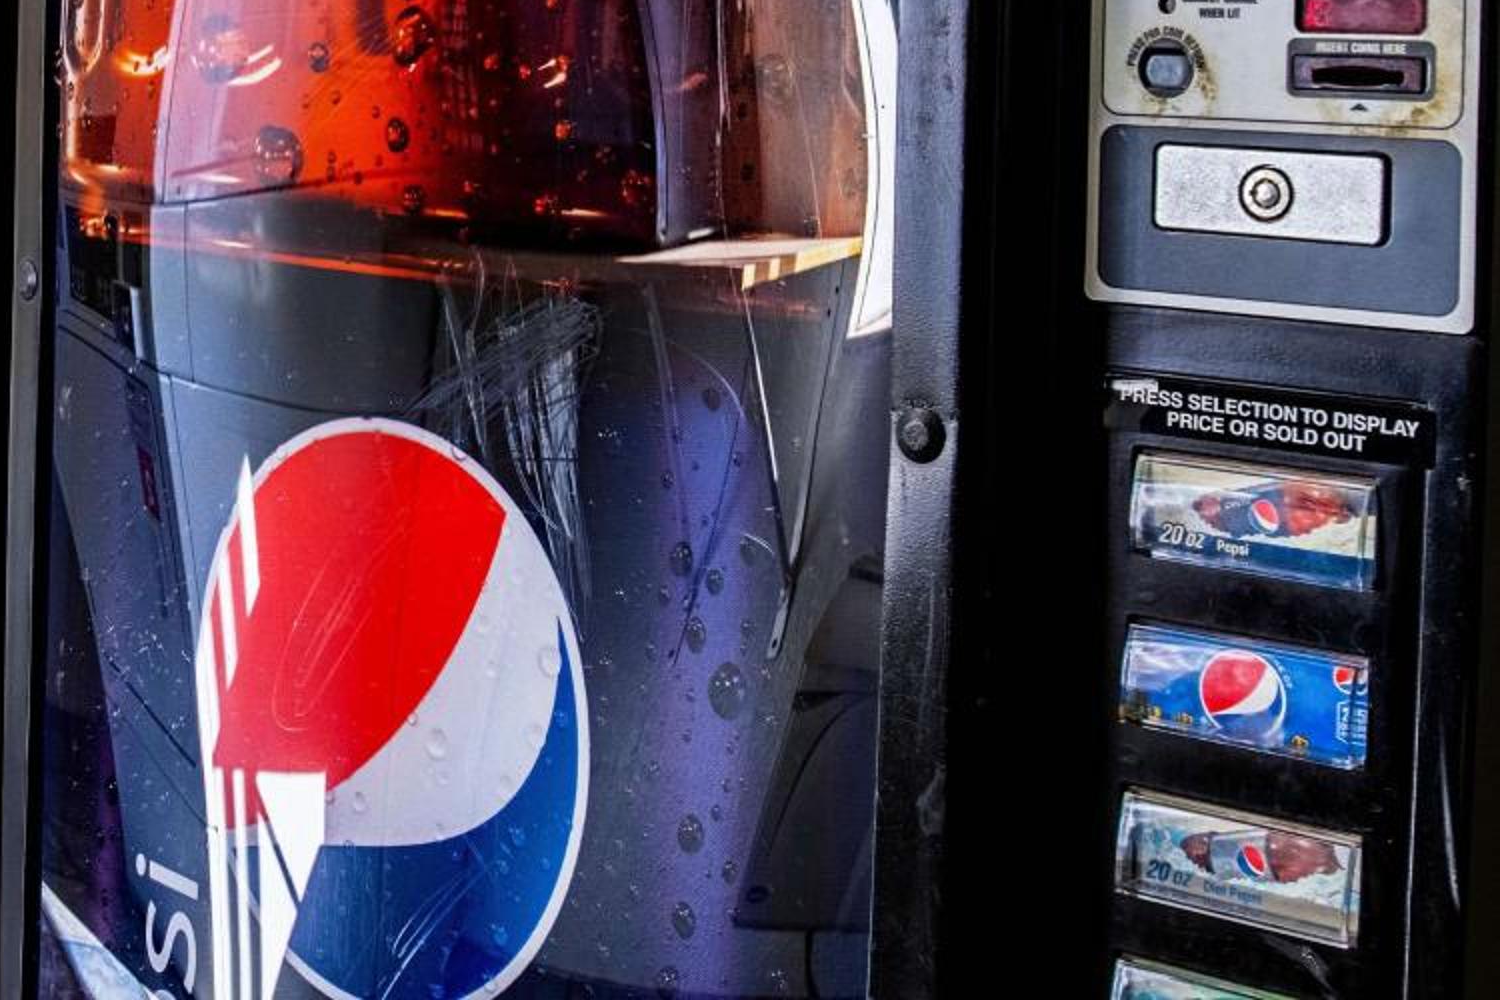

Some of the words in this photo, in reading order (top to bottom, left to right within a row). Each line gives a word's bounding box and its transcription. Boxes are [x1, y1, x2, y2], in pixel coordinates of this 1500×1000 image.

[1200, 8, 1225, 18] WHEN
[1228, 8, 1240, 18] LIT
[1316, 42, 1348, 53] INSERT
[1351, 43, 1380, 54] COINS
[1382, 44, 1406, 54] HERE
[1120, 388, 1184, 409] PRESS
[1187, 393, 1298, 424] SELECTION
[1302, 408, 1328, 427] TO
[1333, 412, 1419, 438] DISPLAY
[1167, 412, 1225, 434] PRICE
[1229, 419, 1259, 437] OR
[1263, 423, 1318, 445] SOLD
[1323, 431, 1366, 452] OUT
[1159, 524, 1183, 546] 20
[1216, 539, 1249, 555] Pepsi
[1149, 859, 1170, 881] 20
